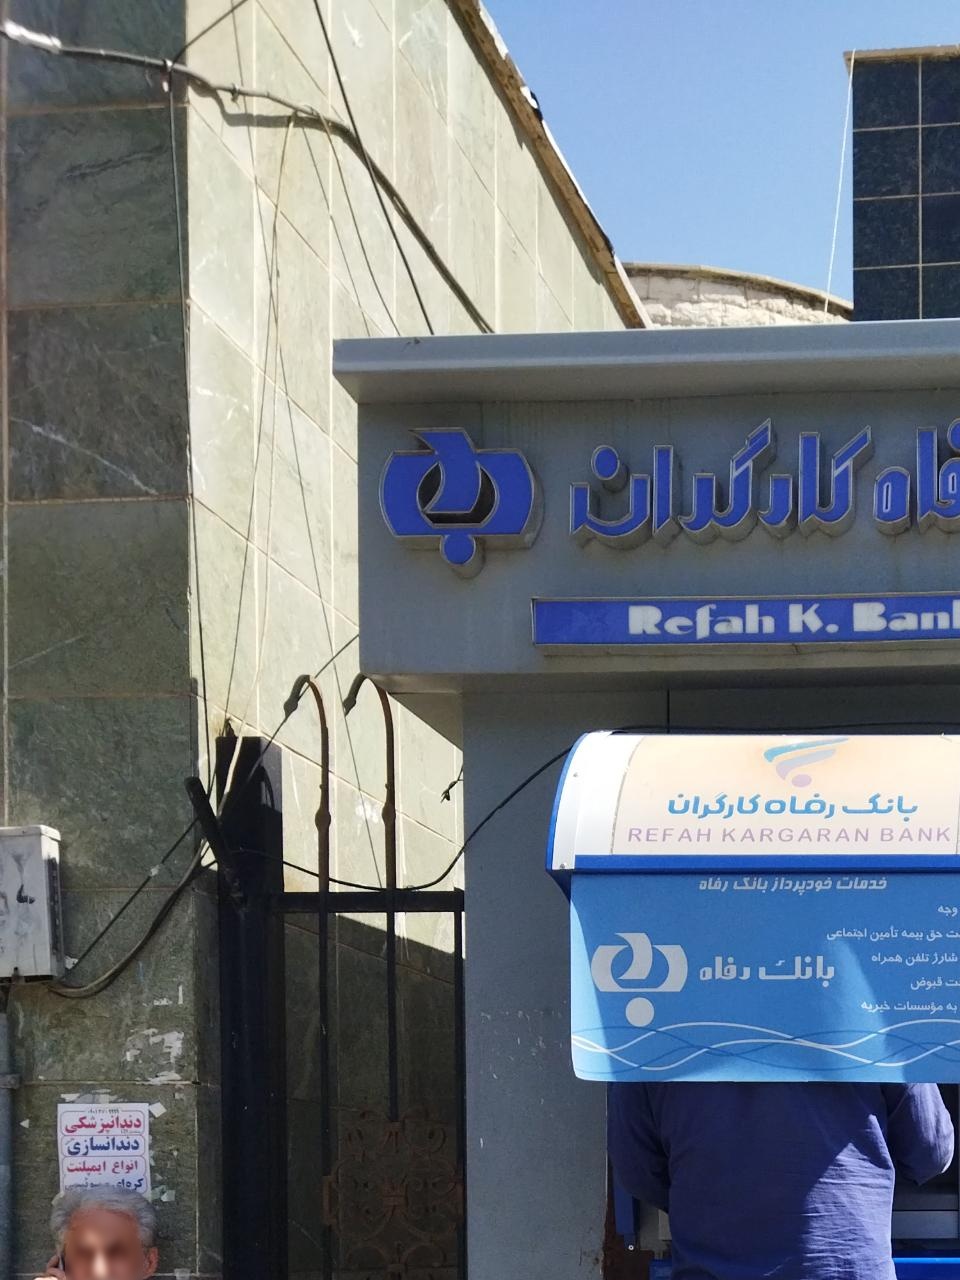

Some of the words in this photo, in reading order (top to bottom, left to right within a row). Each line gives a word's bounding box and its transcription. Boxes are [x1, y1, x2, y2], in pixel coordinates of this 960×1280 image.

[569, 418, 872, 545] کارگران
[628, 604, 775, 640] Refah
[788, 602, 840, 634] K.
[667, 791, 761, 819] کارگران
[764, 793, 835, 818] رفاه
[841, 792, 919, 822] بانک
[627, 827, 712, 843] REFAH
[721, 826, 870, 843] KARGARAN
[879, 826, 952, 843] BANK
[699, 877, 729, 892] رفاه
[733, 877, 768, 893] بانک
[771, 877, 833, 896] خودپرداز
[836, 876, 888, 891] خدمات
[937, 905, 958, 918] وجه
[826, 927, 868, 940] اجتماعی
[869, 925, 899, 942] تأمین
[901, 929, 924, 942] بیمه
[926, 929, 943, 942] حق
[871, 952, 903, 966] همراه
[905, 953, 930, 967] تلفن
[931, 952, 958, 966] شارژ
[699, 956, 751, 981] رفاه
[910, 977, 943, 991] قبوض
[860, 1000, 891, 1014] خیریه
[893, 1000, 944, 1015] مؤسسات
[946, 1001, 958, 1015] به
[64, 1114, 142, 1134] دندانپزشکی
[66, 1136, 140, 1156] دندانسازی
[66, 1160, 107, 1175] ایمپلنت
[111, 1160, 138, 1174] انواع
